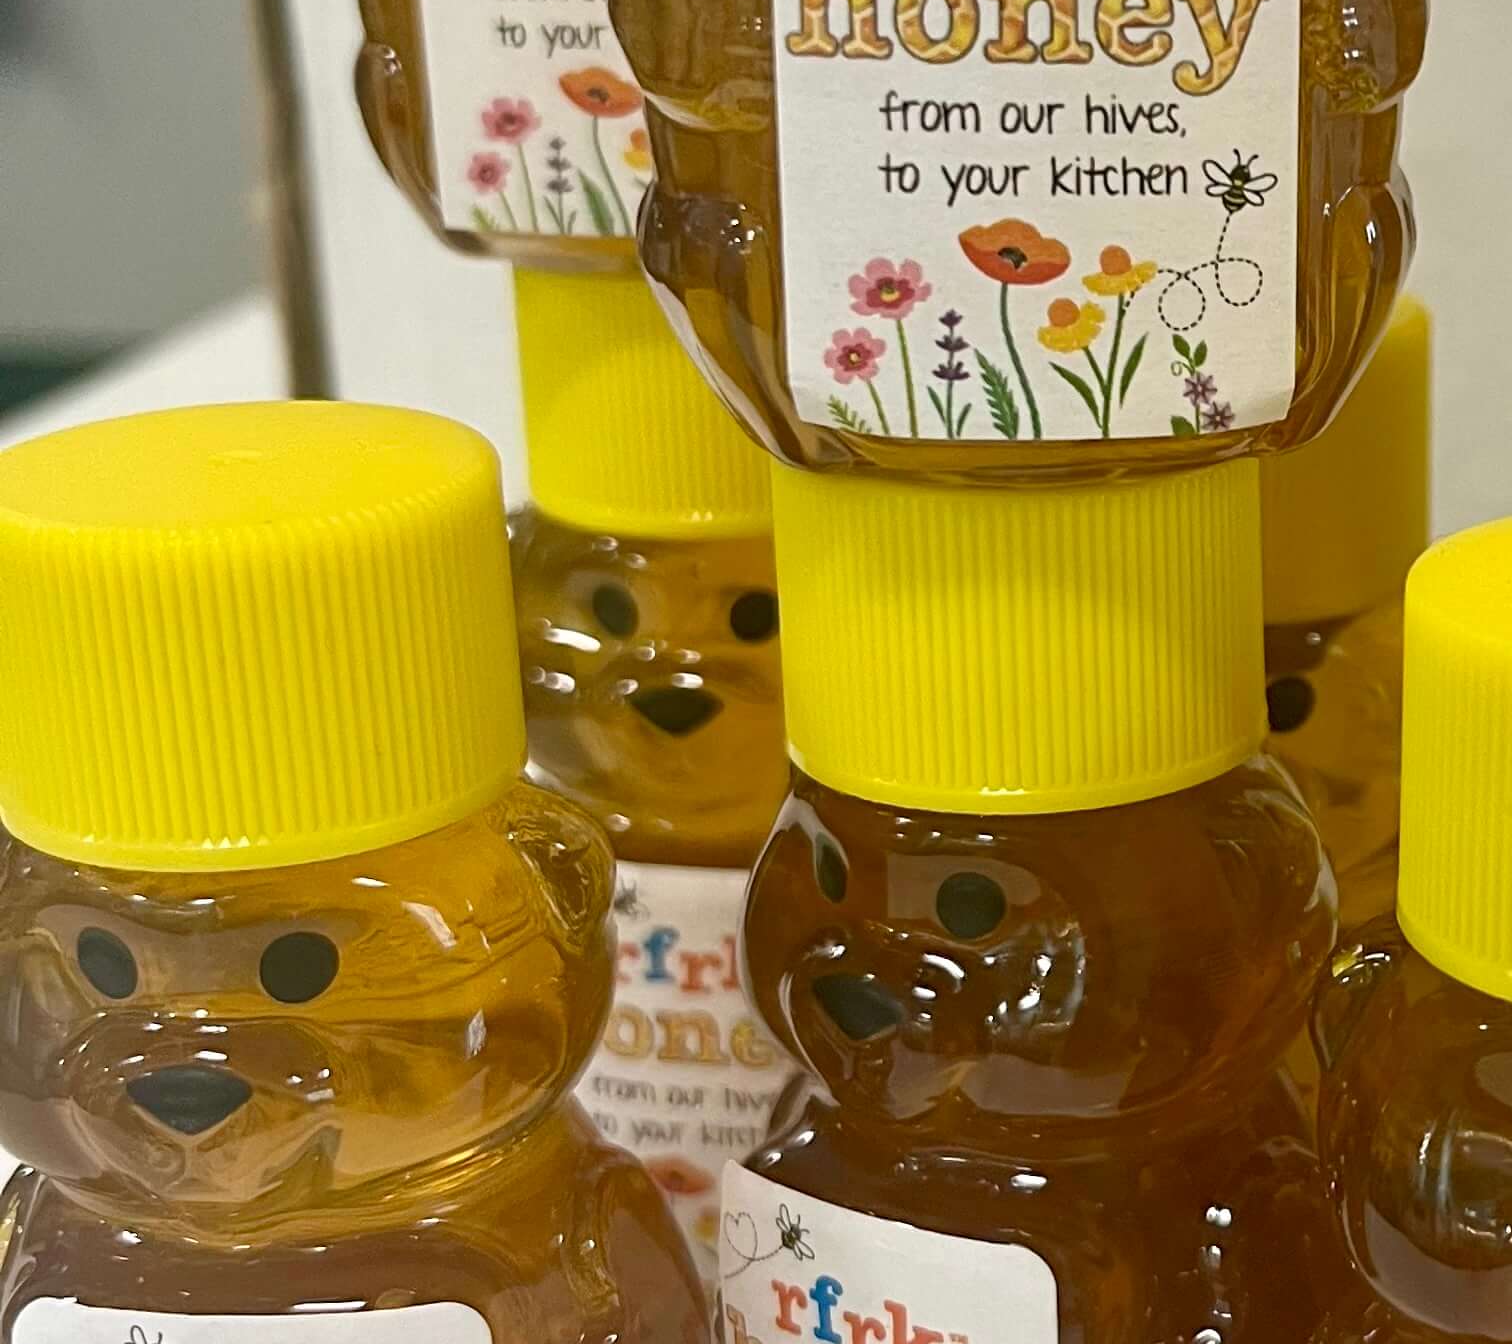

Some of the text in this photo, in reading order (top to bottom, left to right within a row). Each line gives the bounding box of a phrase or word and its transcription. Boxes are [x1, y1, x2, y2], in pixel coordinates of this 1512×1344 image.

[496, 16, 607, 59] to your
[879, 91, 1187, 138] from our hives,
[879, 153, 1188, 205] to your kitchen
